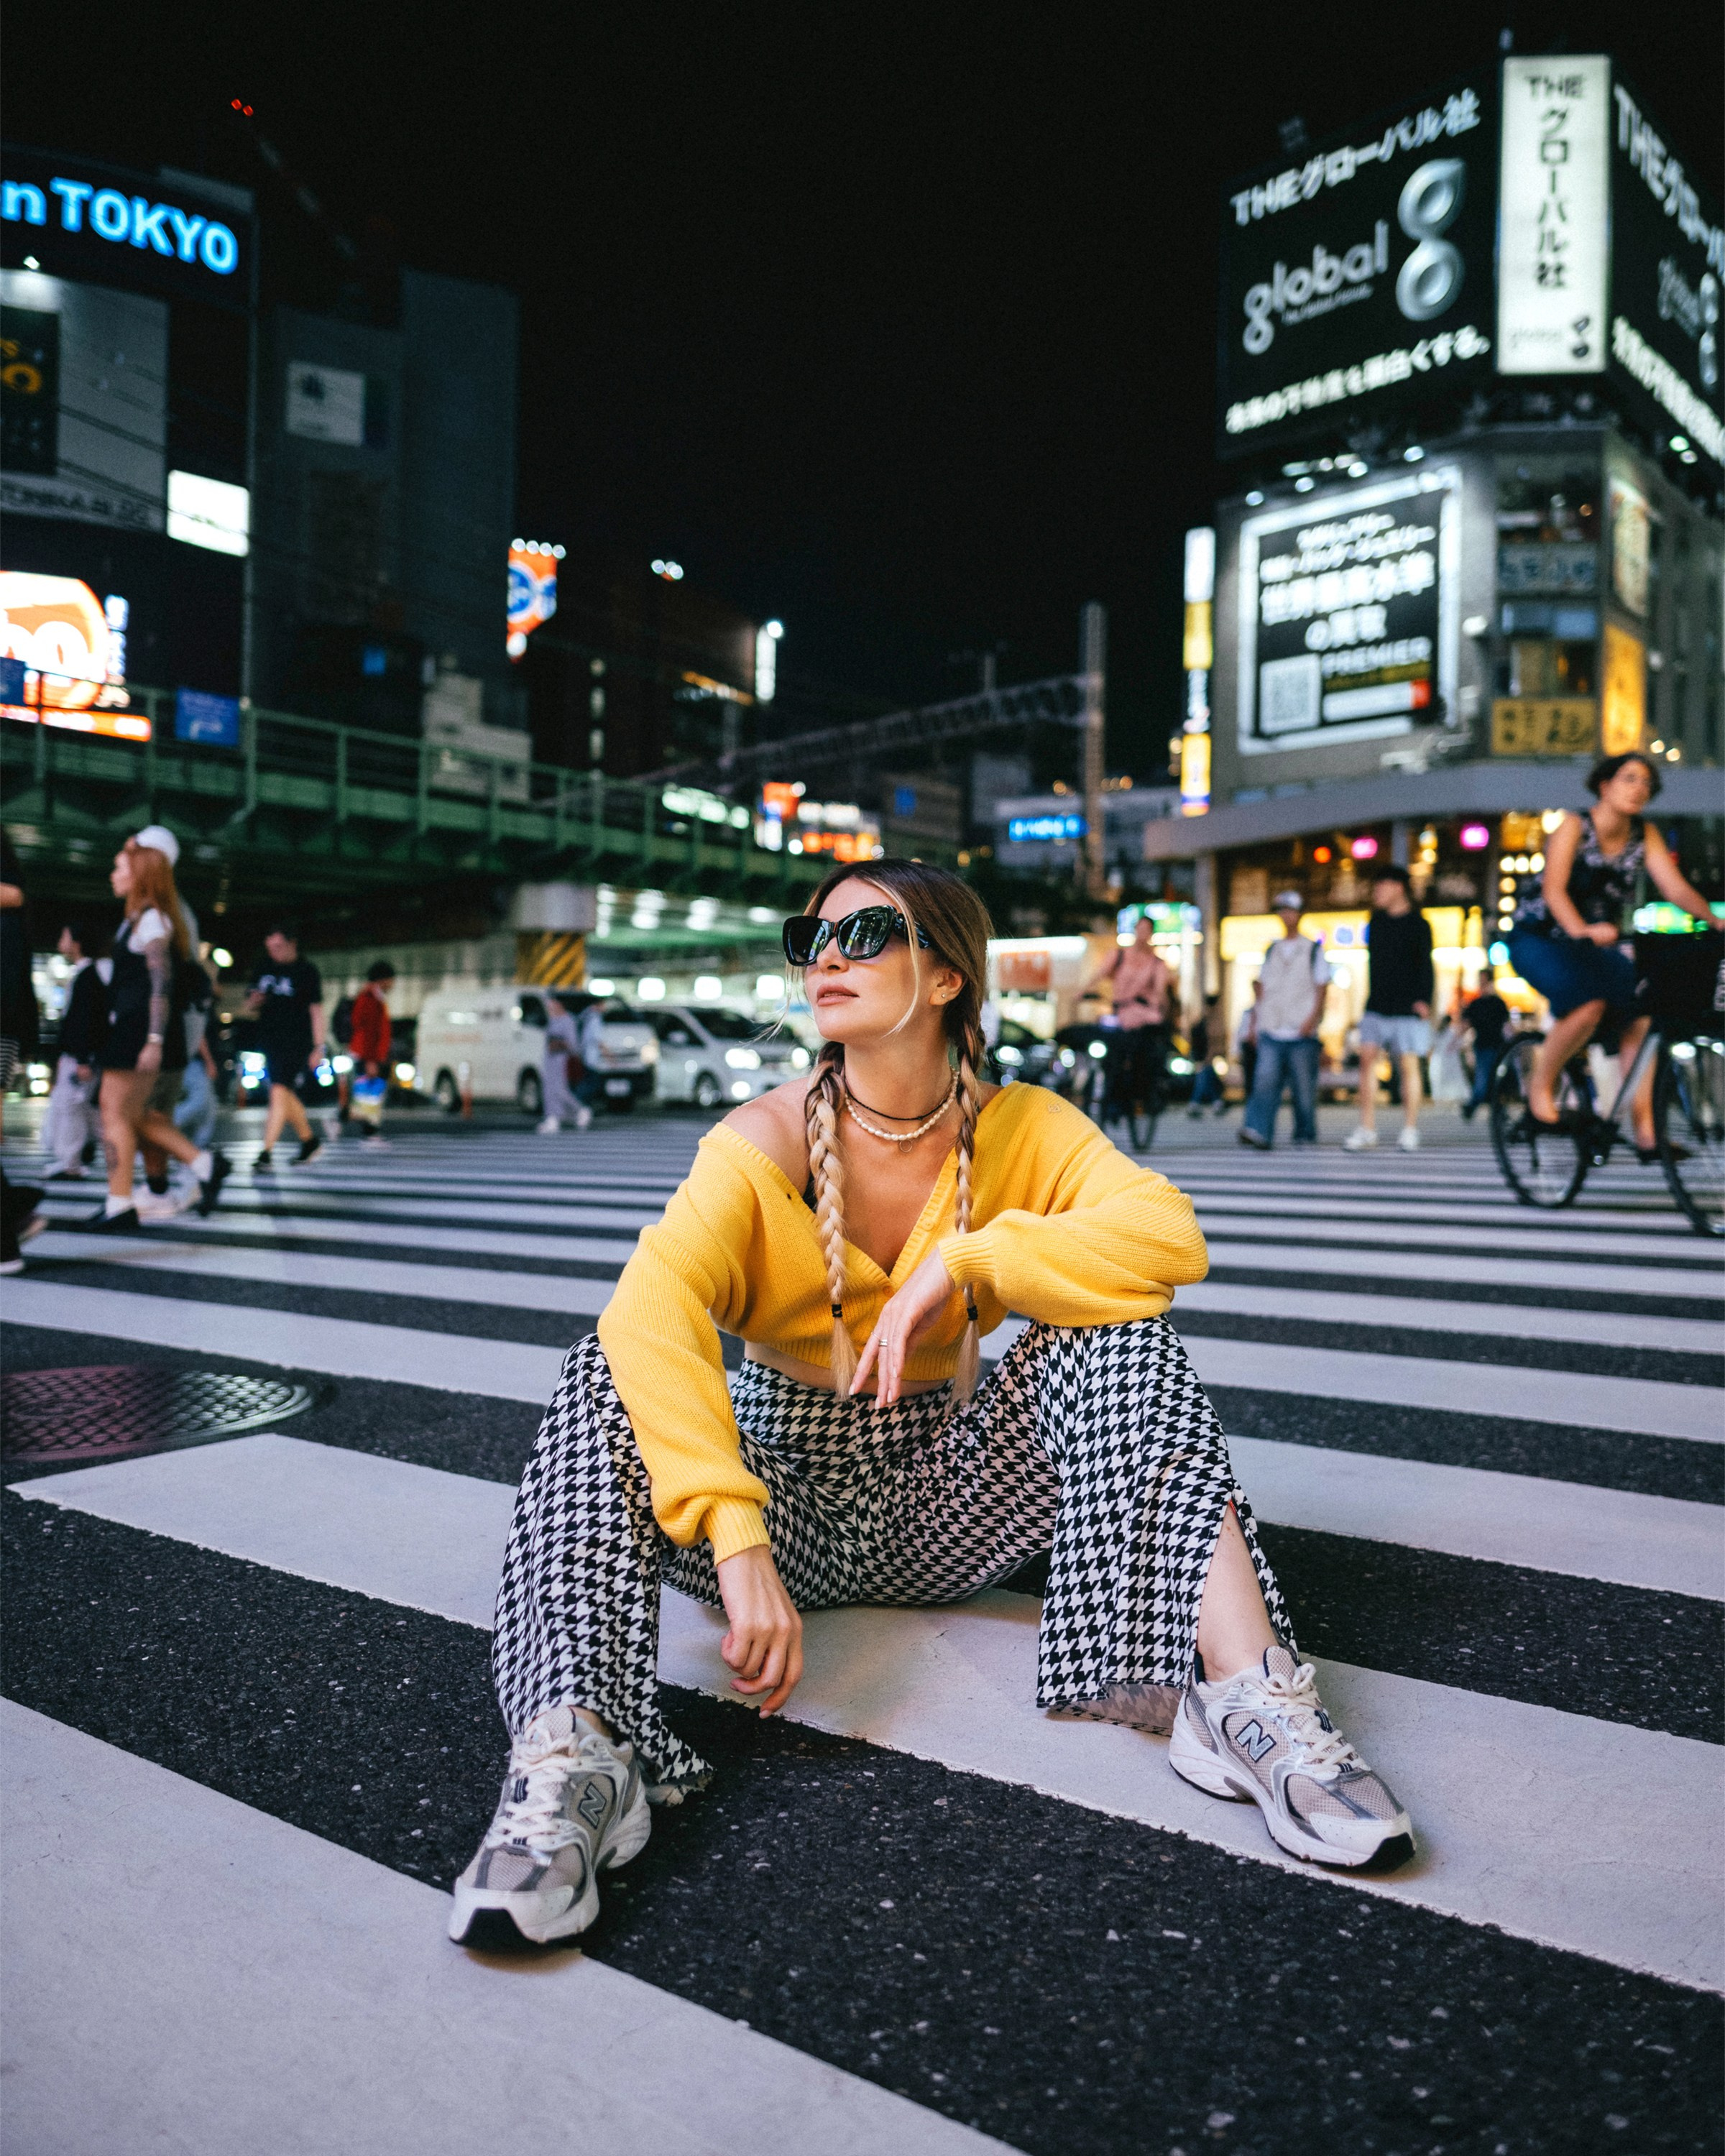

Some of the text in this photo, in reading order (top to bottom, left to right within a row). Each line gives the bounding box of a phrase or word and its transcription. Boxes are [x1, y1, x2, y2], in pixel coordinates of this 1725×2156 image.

[1525, 73, 1584, 99] THE
[50, 177, 239, 275] TOKYO
[1242, 219, 1389, 355] global
[1321, 635, 1432, 679] PREMIER
[1236, 1718, 1277, 1762] N
[577, 1782, 607, 1830] N
